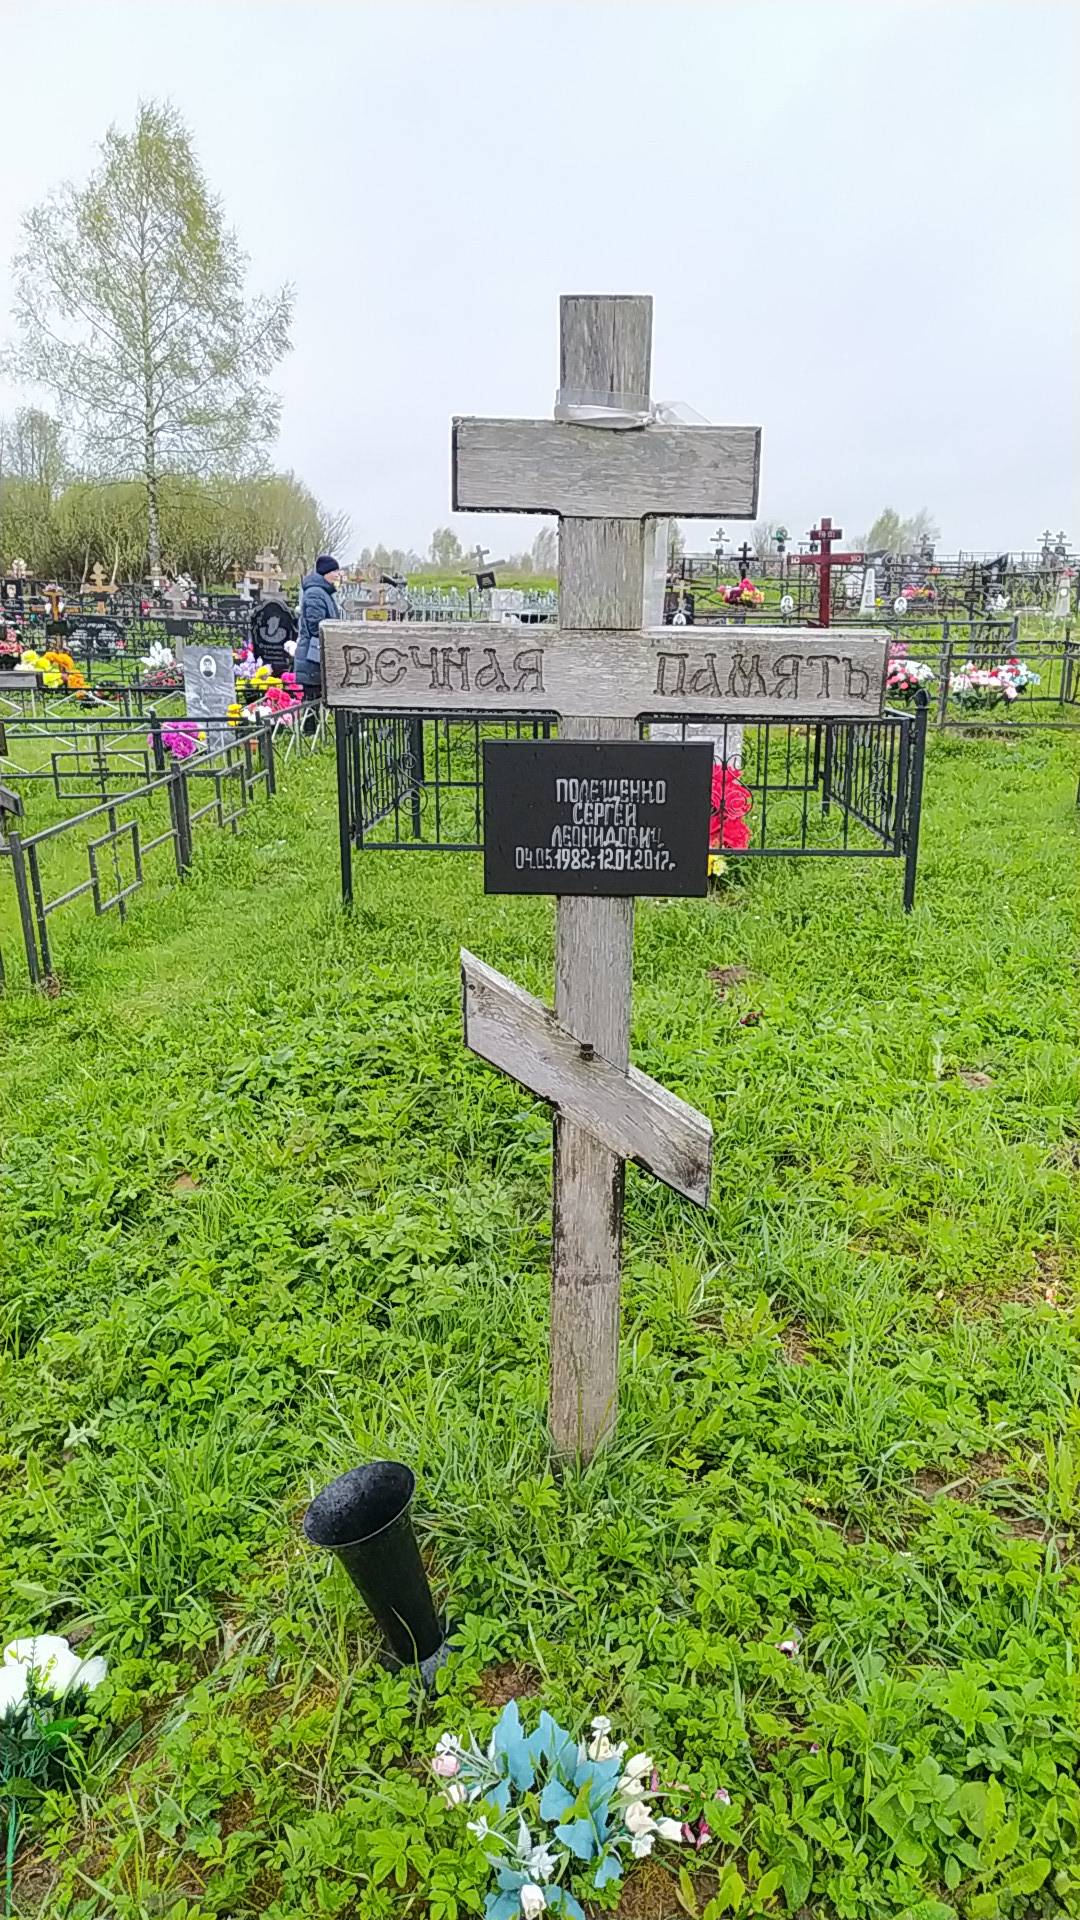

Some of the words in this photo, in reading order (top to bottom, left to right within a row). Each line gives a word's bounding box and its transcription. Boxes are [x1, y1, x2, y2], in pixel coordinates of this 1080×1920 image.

[339, 645, 545, 693] ВЕЧНАЯ
[653, 652, 871, 699] ПАМЯТЬ
[572, 802, 637, 826] СЕРГЕЙ
[551, 824, 664, 848] ЛЕОНИДОВИЧ
